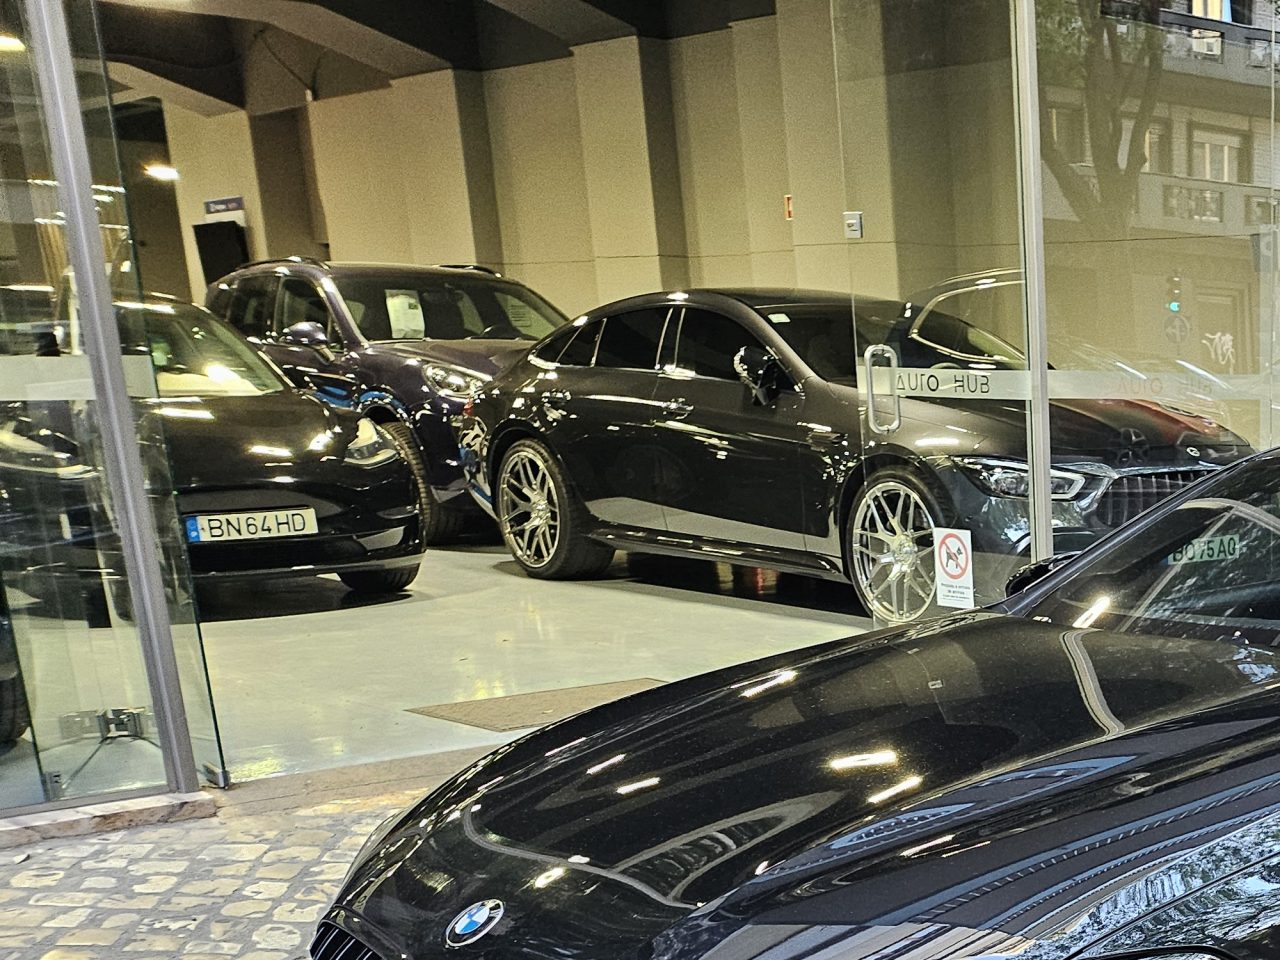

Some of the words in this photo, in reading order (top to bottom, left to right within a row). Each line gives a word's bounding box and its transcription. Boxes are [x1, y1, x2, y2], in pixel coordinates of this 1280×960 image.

[896, 373, 940, 392] AUTO
[954, 374, 990, 394] HUB
[207, 512, 306, 538] BN64HD
